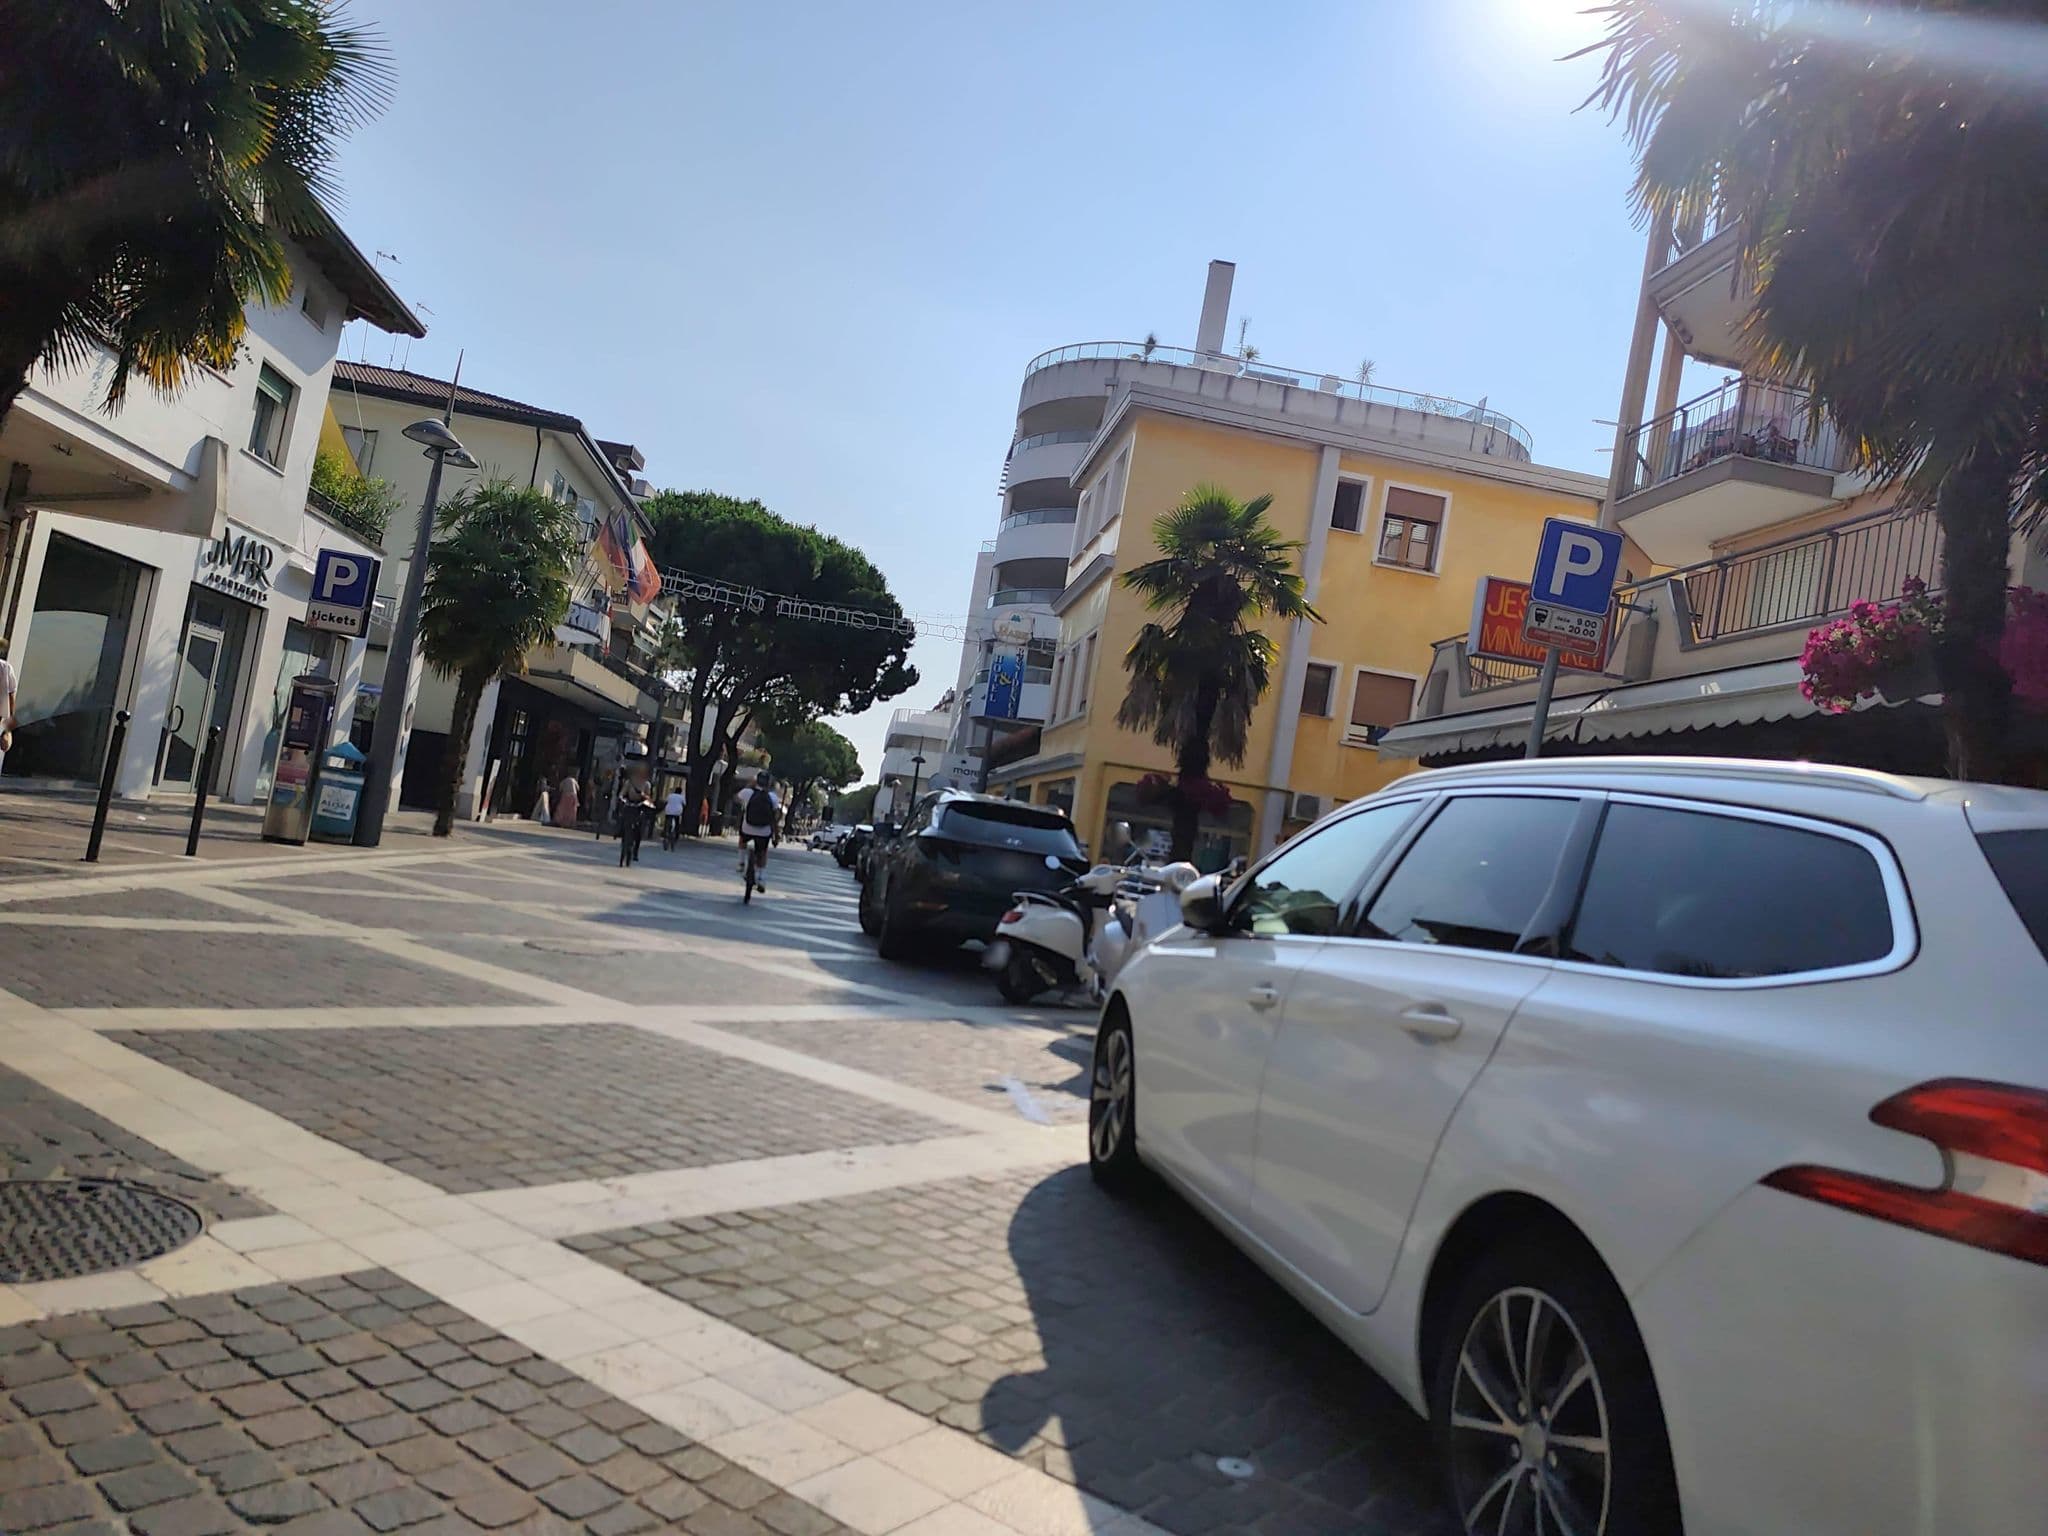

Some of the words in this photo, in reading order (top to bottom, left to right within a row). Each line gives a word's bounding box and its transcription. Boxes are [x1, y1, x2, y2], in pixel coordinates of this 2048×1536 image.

[321, 556, 359, 598] P
[1549, 530, 1604, 596] P
[207, 572, 268, 602] APARTMENTS
[311, 609, 356, 626] tickets
[990, 655, 1004, 702] HOTEL
